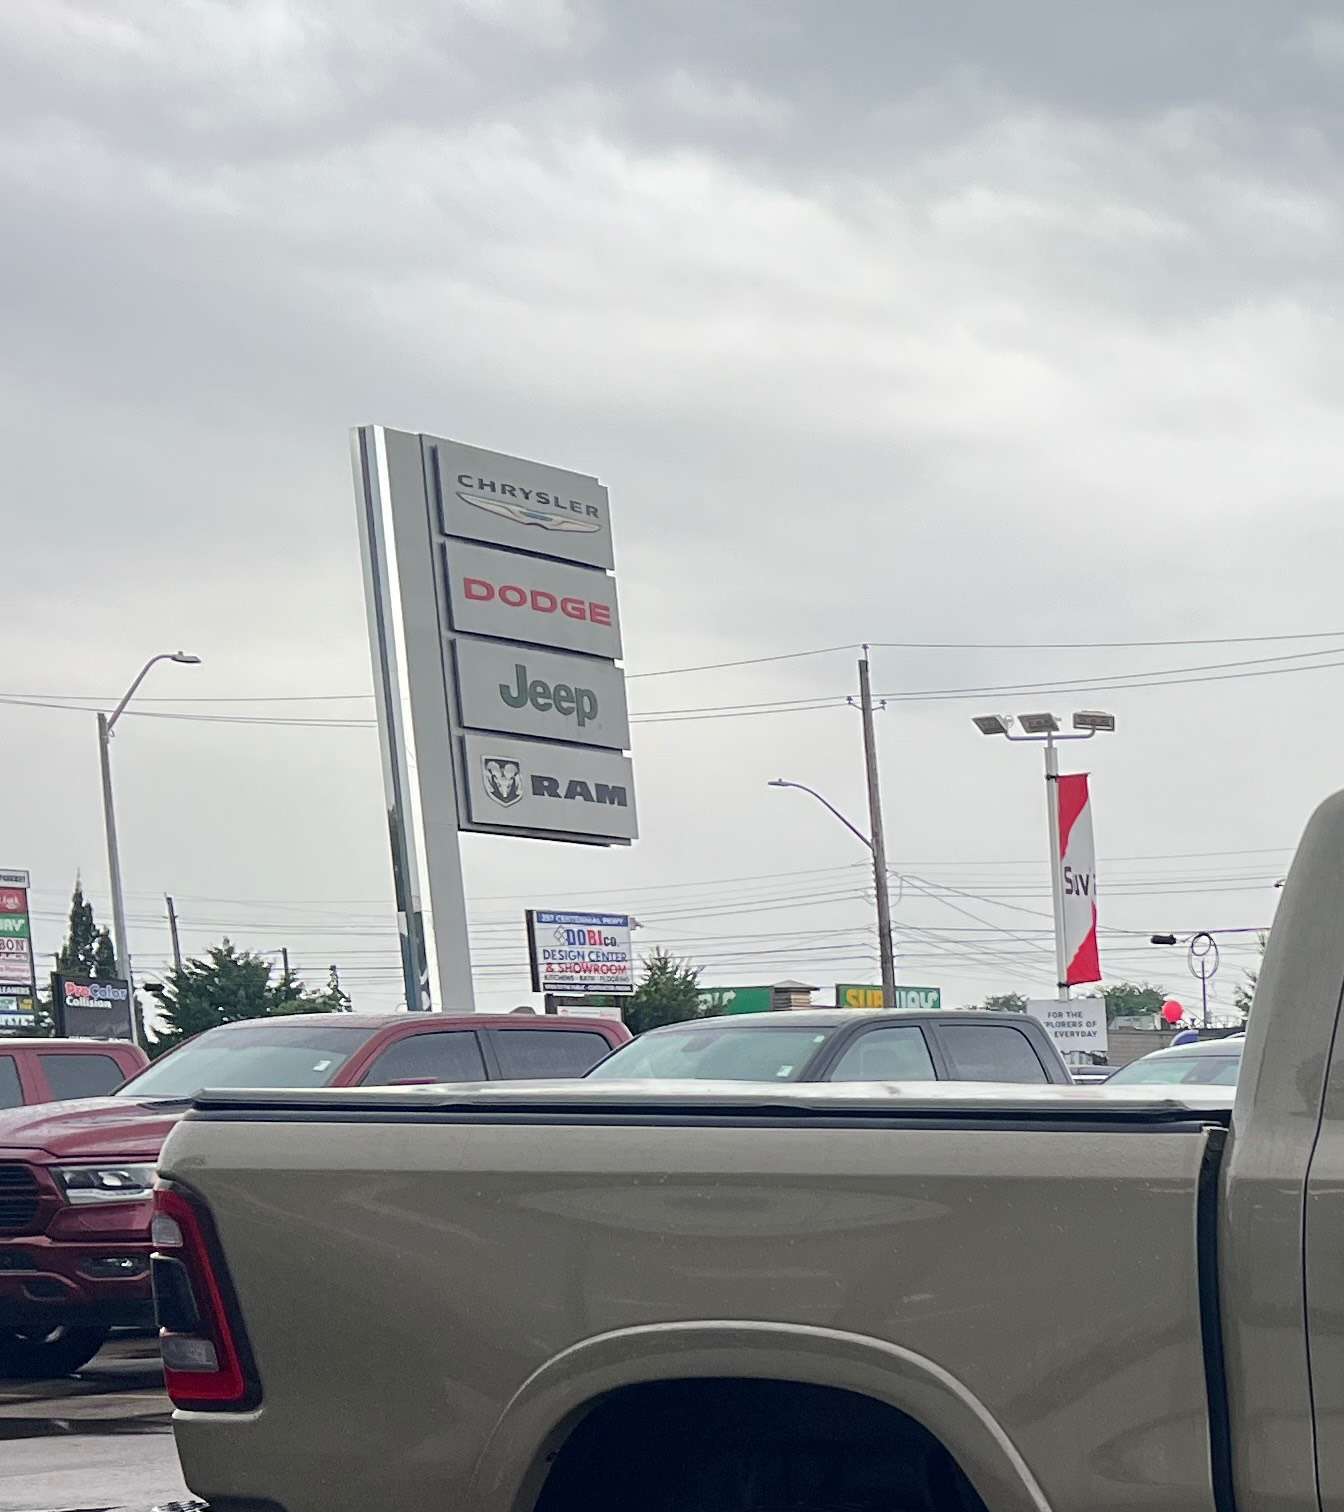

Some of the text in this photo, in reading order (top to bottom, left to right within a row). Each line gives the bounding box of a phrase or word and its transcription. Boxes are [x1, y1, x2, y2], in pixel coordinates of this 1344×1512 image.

[457, 474, 600, 519] CHRYSLER
[463, 576, 612, 627] DODGE
[499, 664, 598, 727] Jeep
[530, 774, 628, 808] RAM
[543, 949, 627, 963] DESIGN CENTER
[558, 962, 627, 975] SHOWROOM
[64, 981, 127, 1000] ProColor
[65, 996, 112, 1009] Collision
[1066, 1011, 1083, 1019] THE
[1054, 1030, 1097, 1038] EVERYDAY
